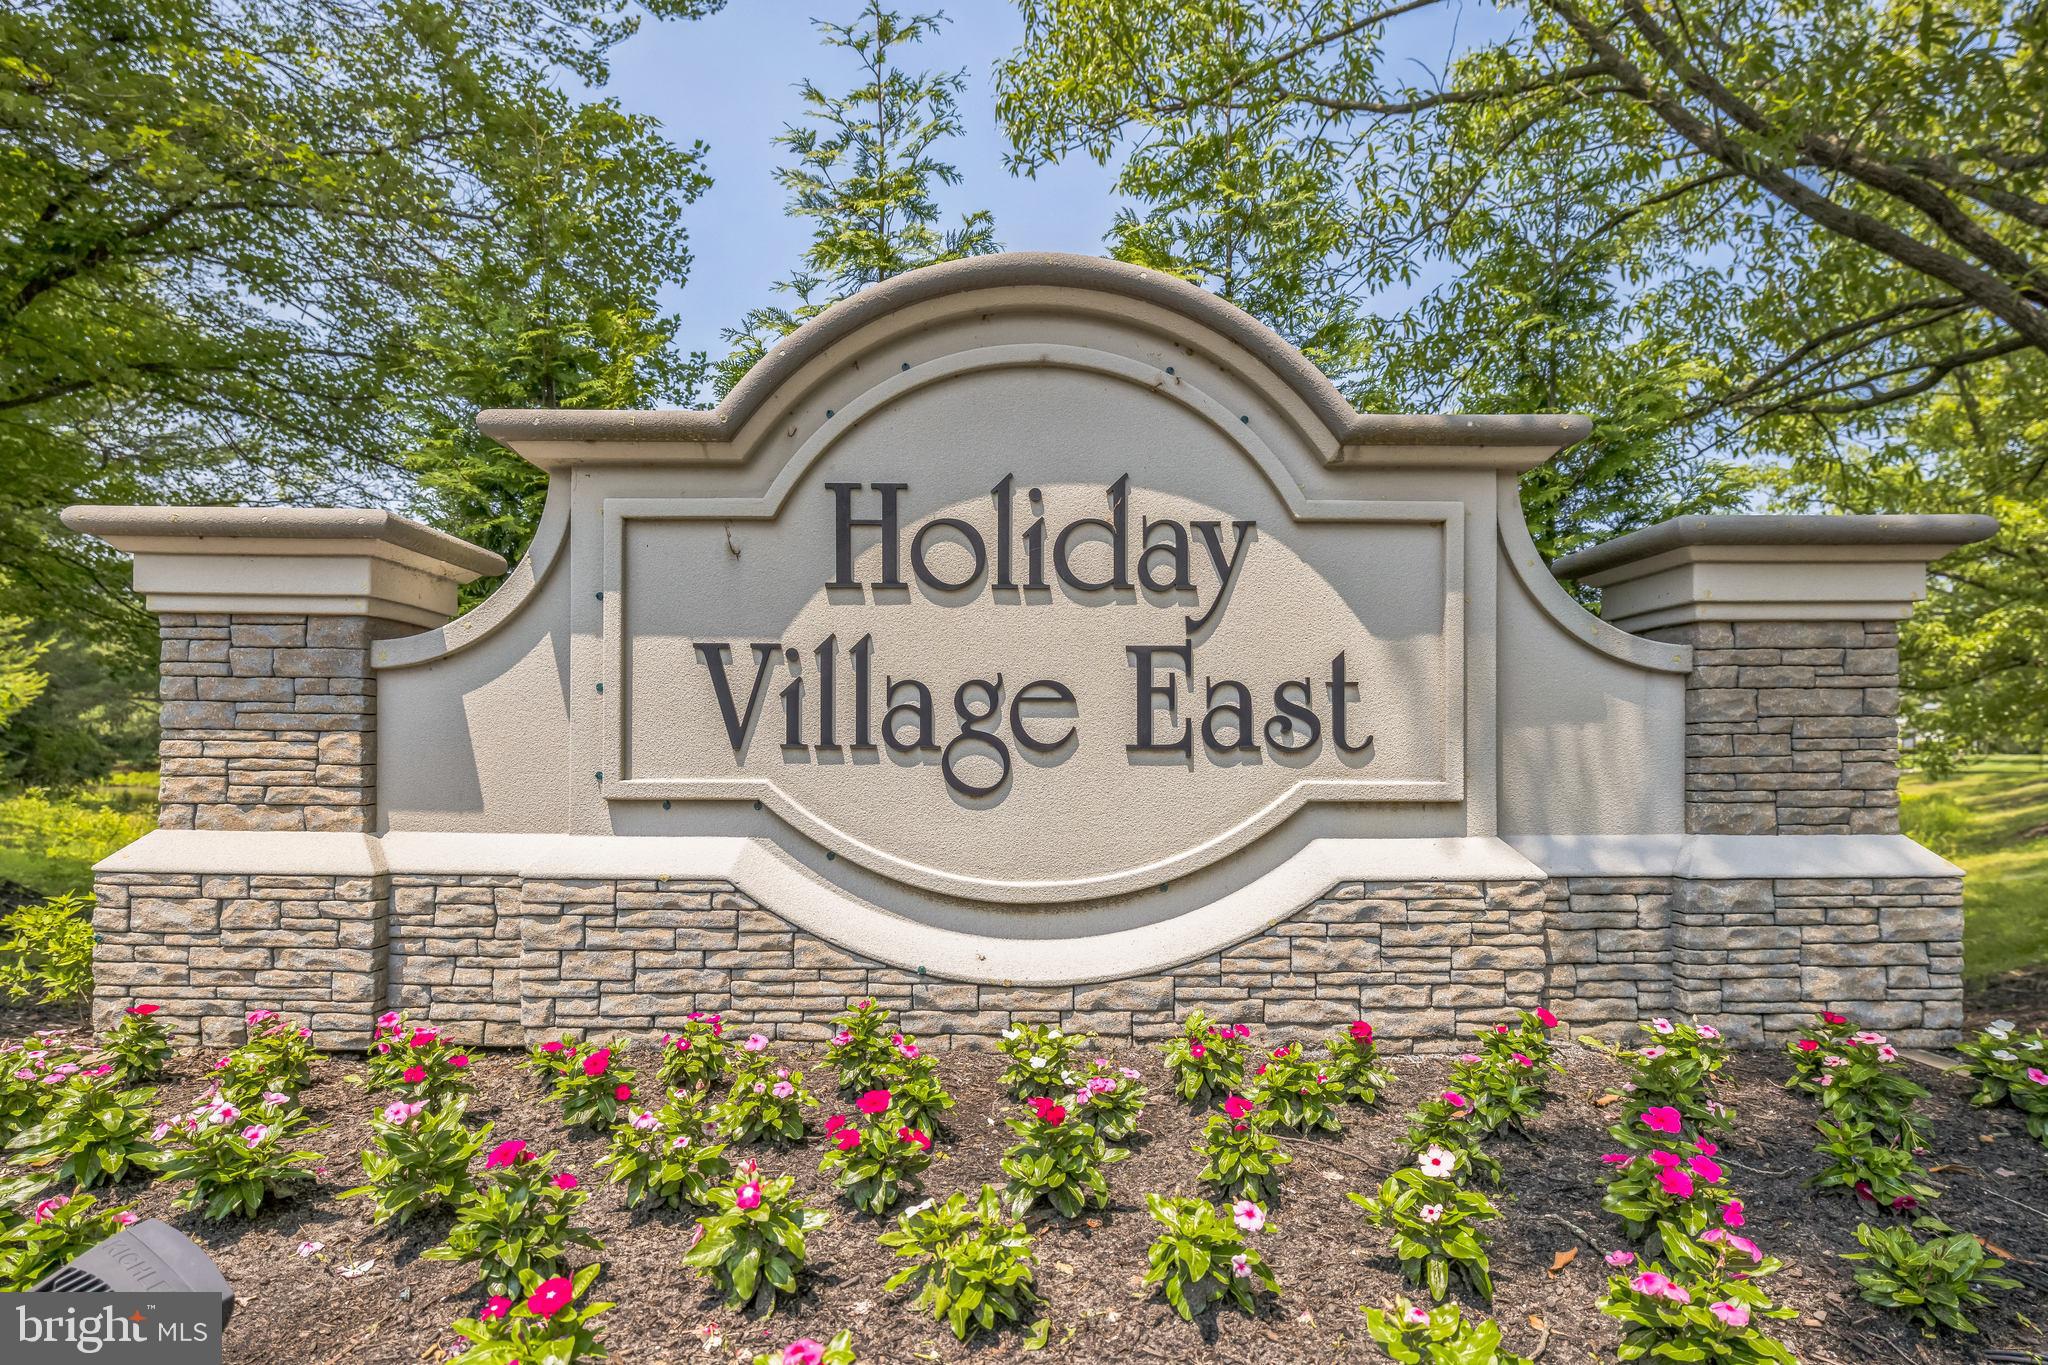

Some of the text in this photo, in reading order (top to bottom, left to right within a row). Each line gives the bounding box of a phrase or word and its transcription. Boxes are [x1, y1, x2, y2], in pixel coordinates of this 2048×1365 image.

[824, 472, 1257, 636] Holiday
[692, 632, 1375, 800] Village East
